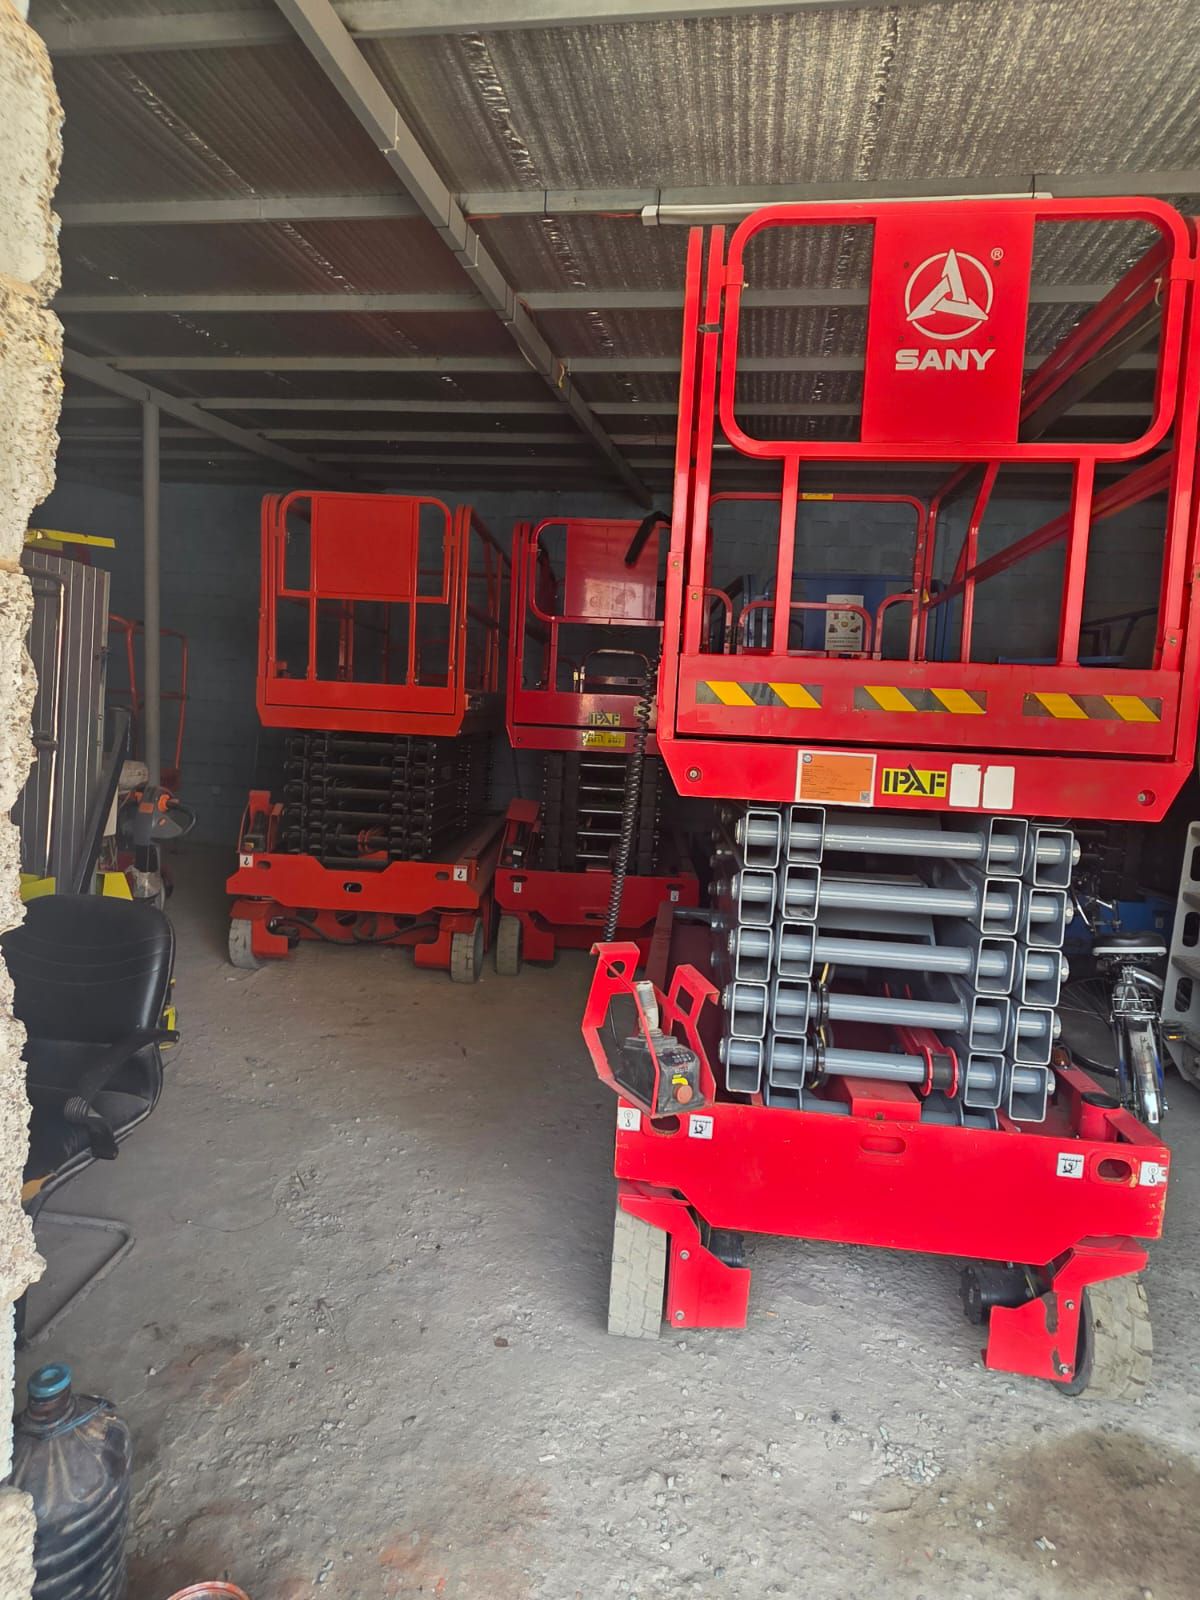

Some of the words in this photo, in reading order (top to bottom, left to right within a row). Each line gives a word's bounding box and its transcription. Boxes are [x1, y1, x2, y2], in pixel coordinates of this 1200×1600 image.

[895, 349, 997, 371] SANY
[590, 710, 619, 725] IPAF
[884, 764, 945, 795] IPAF
